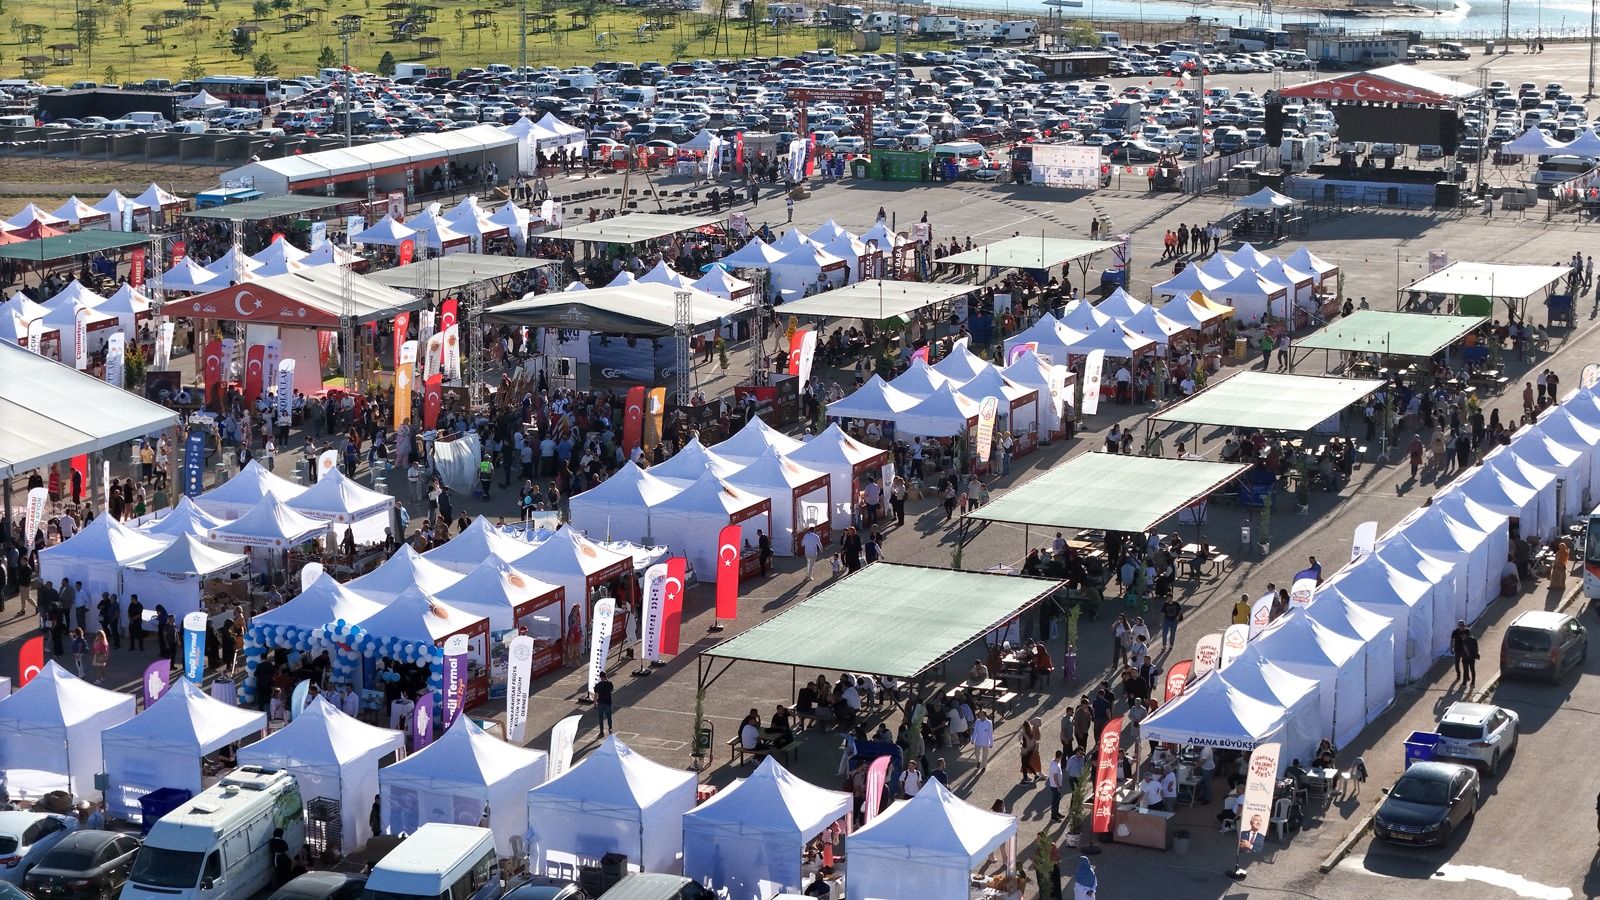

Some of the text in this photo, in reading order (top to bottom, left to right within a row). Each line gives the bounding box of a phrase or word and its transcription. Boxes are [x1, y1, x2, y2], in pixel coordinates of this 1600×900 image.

[447, 658, 458, 697] Termal
[1187, 737, 1257, 752] ADANA BÜYÜKŞE
